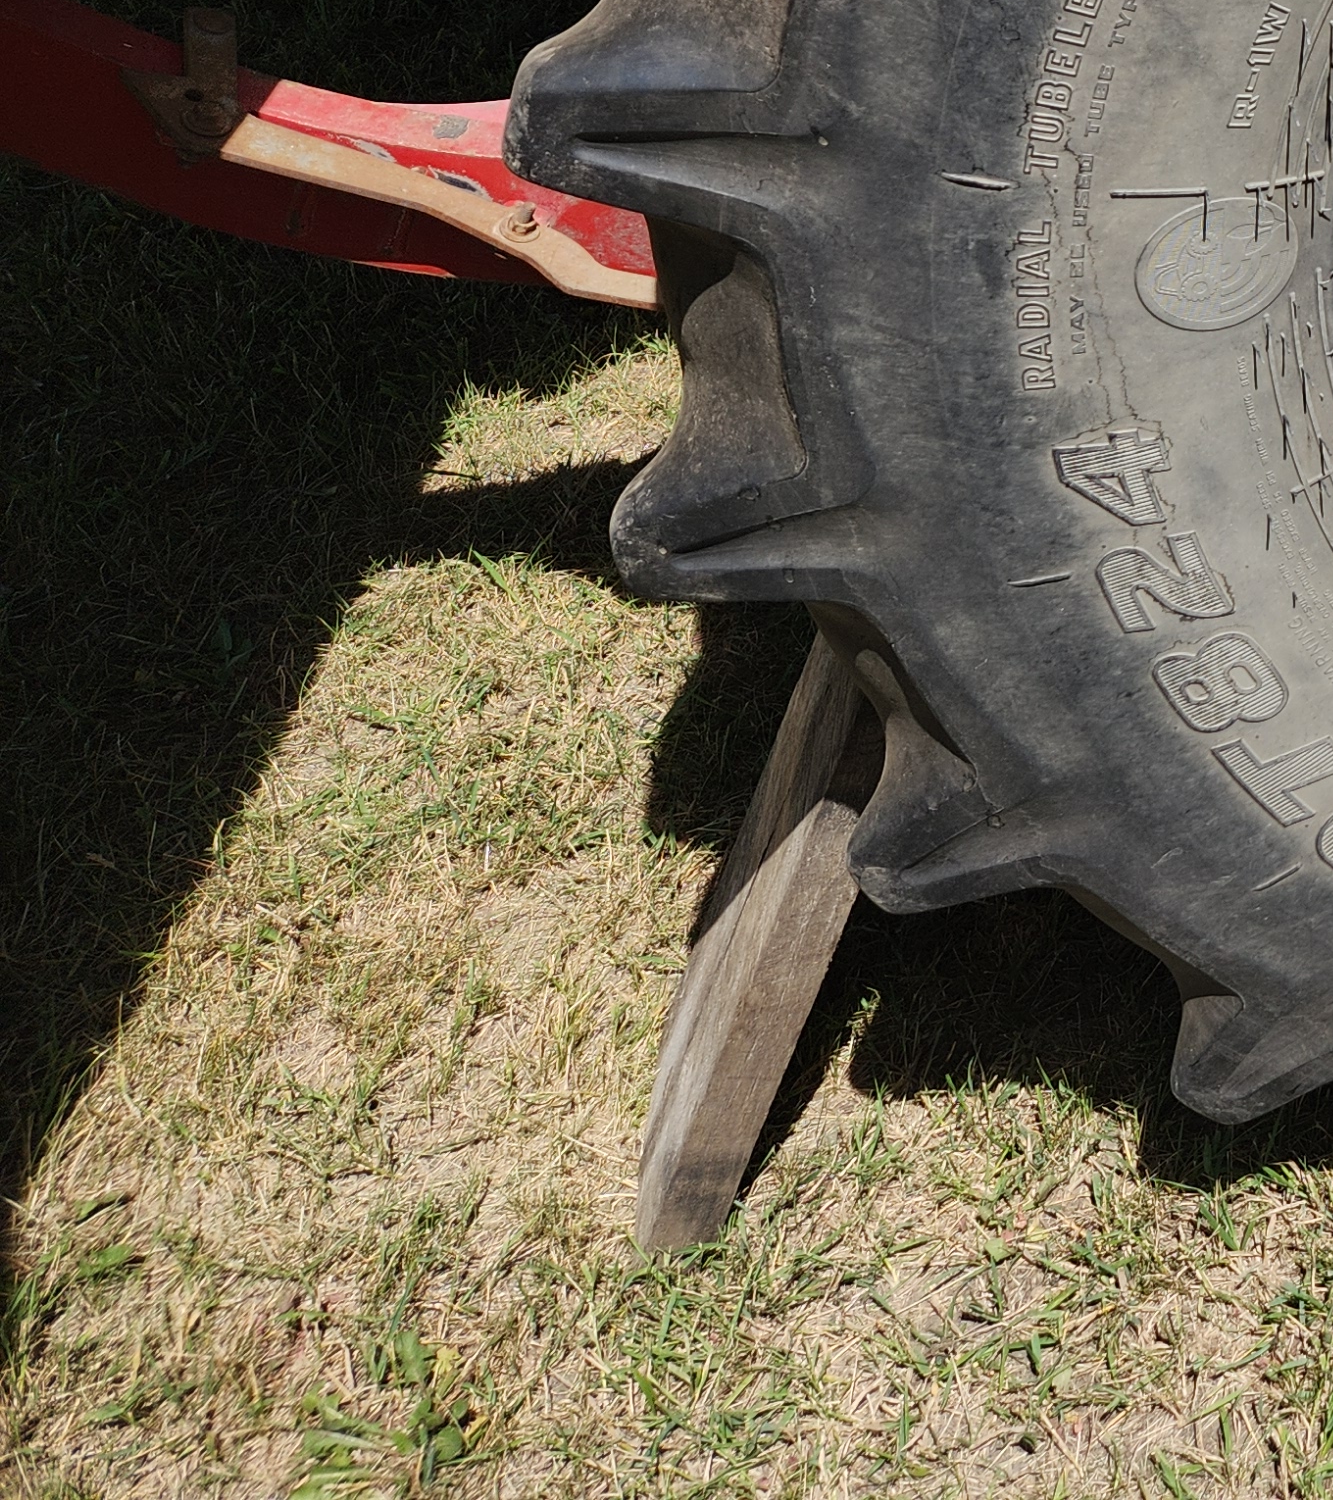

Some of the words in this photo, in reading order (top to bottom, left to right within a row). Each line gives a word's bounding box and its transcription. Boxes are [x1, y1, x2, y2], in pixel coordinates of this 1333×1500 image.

[1085, 63, 1116, 137] TUBE
[1227, 2, 1292, 129] R-1W
[1072, 153, 1095, 228] USED
[1070, 242, 1086, 279] BE
[1021, 218, 1057, 392] RADIAL
[1071, 295, 1088, 356] MAY
